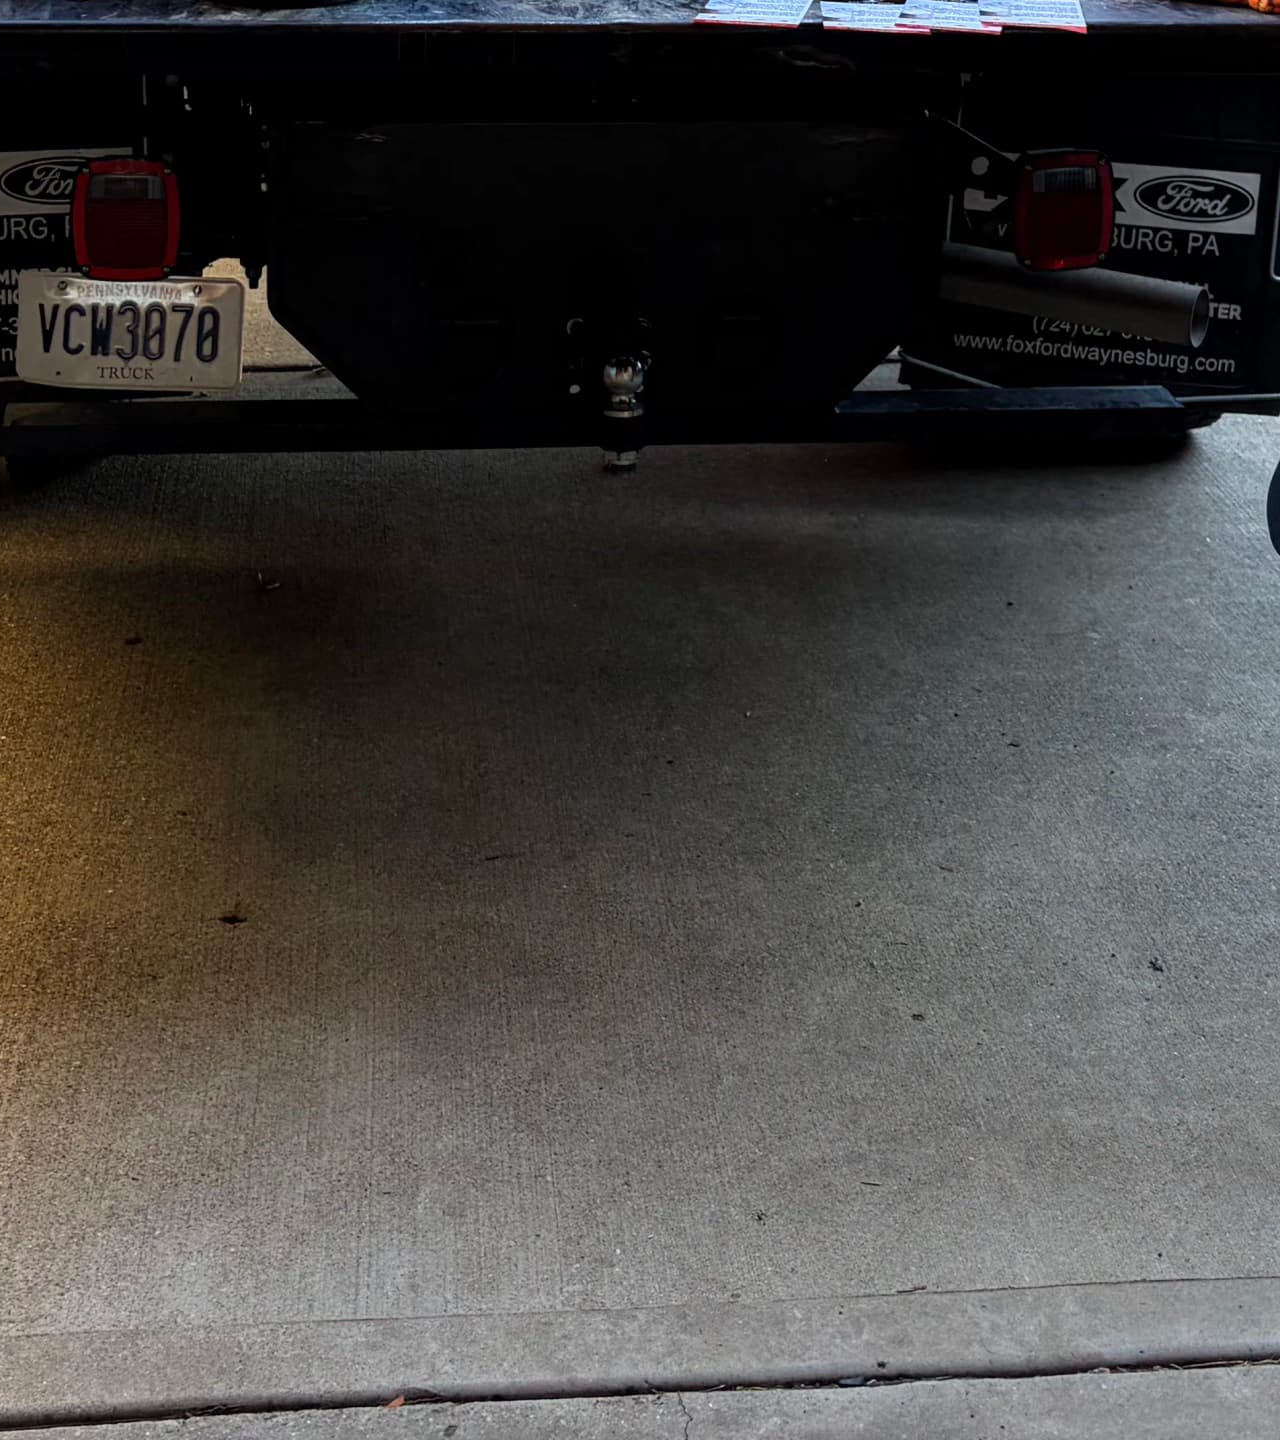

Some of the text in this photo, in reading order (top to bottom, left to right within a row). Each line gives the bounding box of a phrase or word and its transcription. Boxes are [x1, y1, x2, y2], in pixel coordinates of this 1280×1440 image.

[1156, 181, 1233, 216] Ford
[1187, 231, 1220, 257] PA
[76, 284, 183, 301] PENNSYLVANIA
[1209, 301, 1243, 320] TER
[38, 299, 221, 363] VCW3070
[953, 332, 1237, 374] www.foxfordwaynesburg.com
[96, 365, 155, 381] TRUCK
